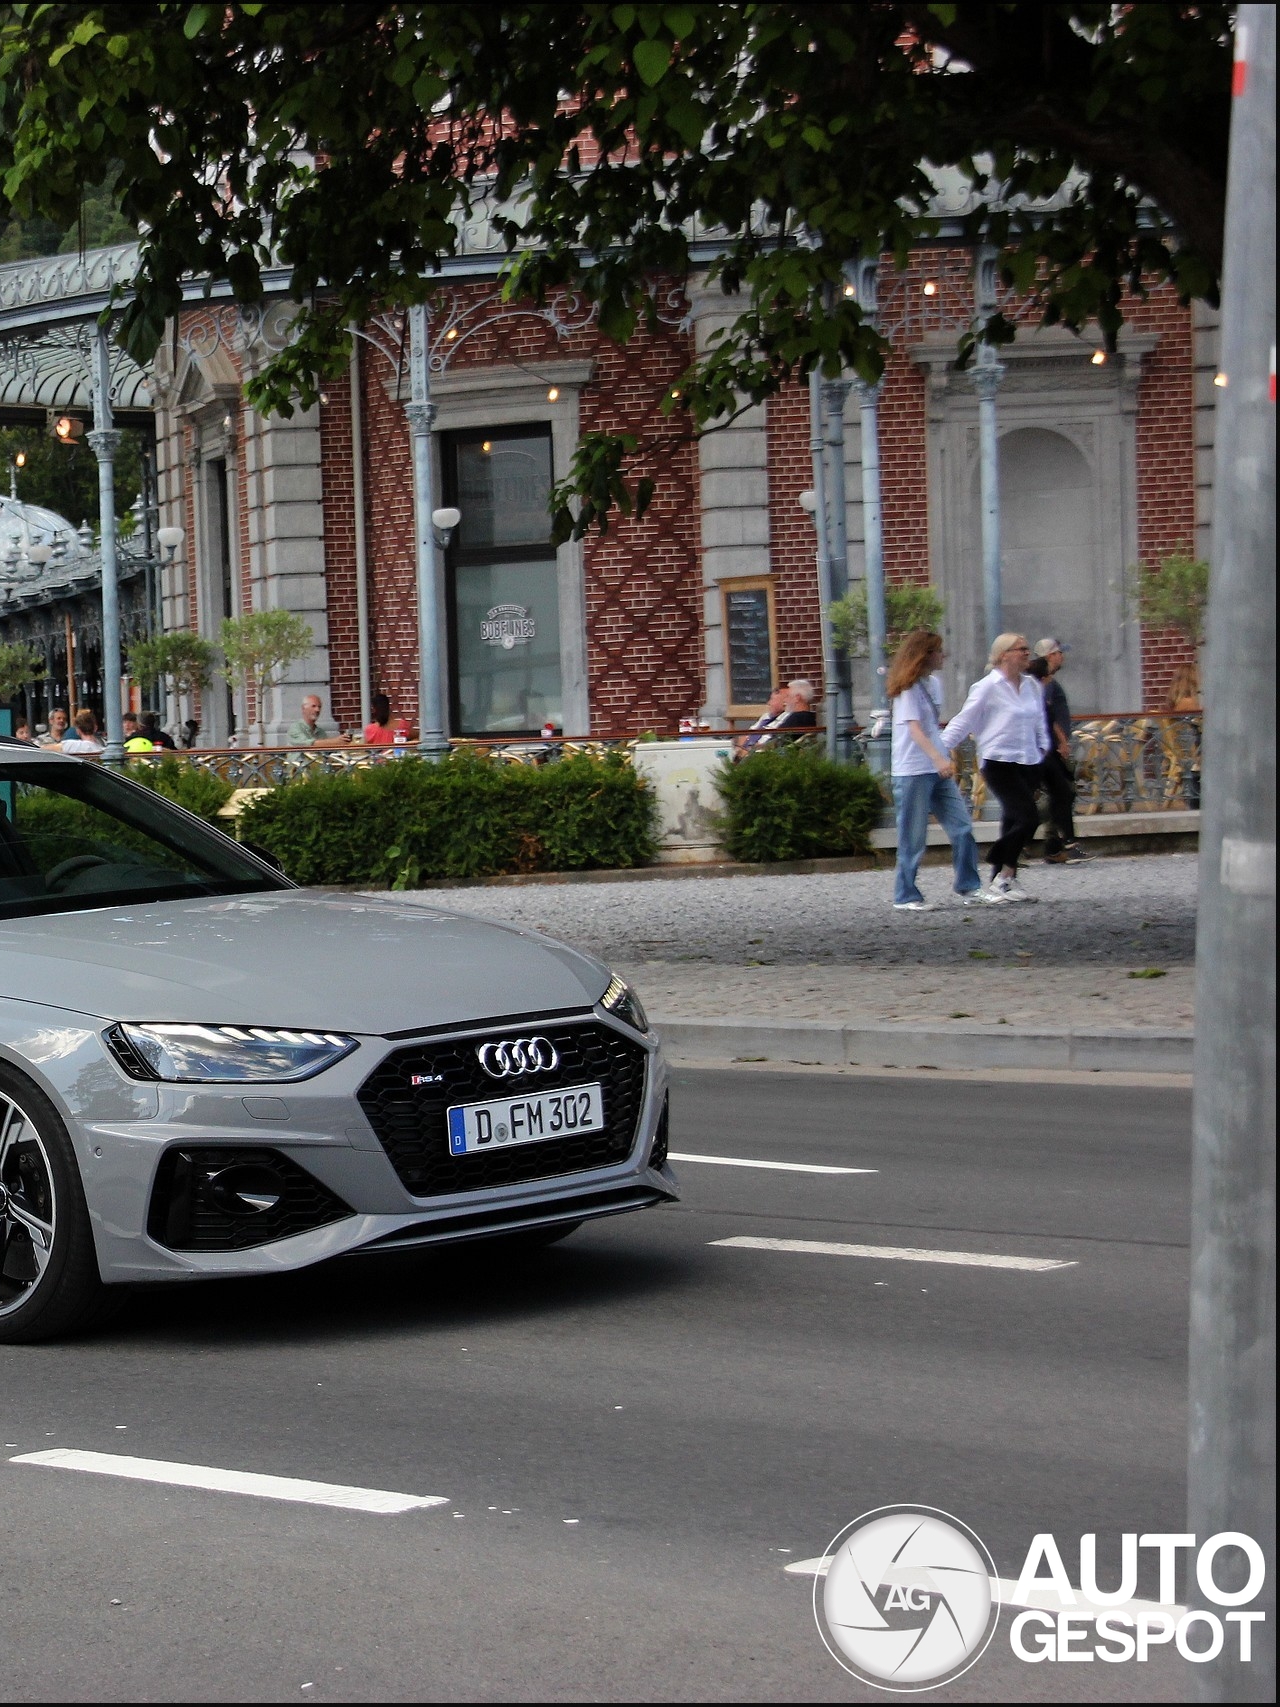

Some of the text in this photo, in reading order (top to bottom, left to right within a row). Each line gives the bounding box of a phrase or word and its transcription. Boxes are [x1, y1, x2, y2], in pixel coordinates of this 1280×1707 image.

[475, 1092, 593, 1144] D FM 302
[455, 1135, 462, 1146] D
